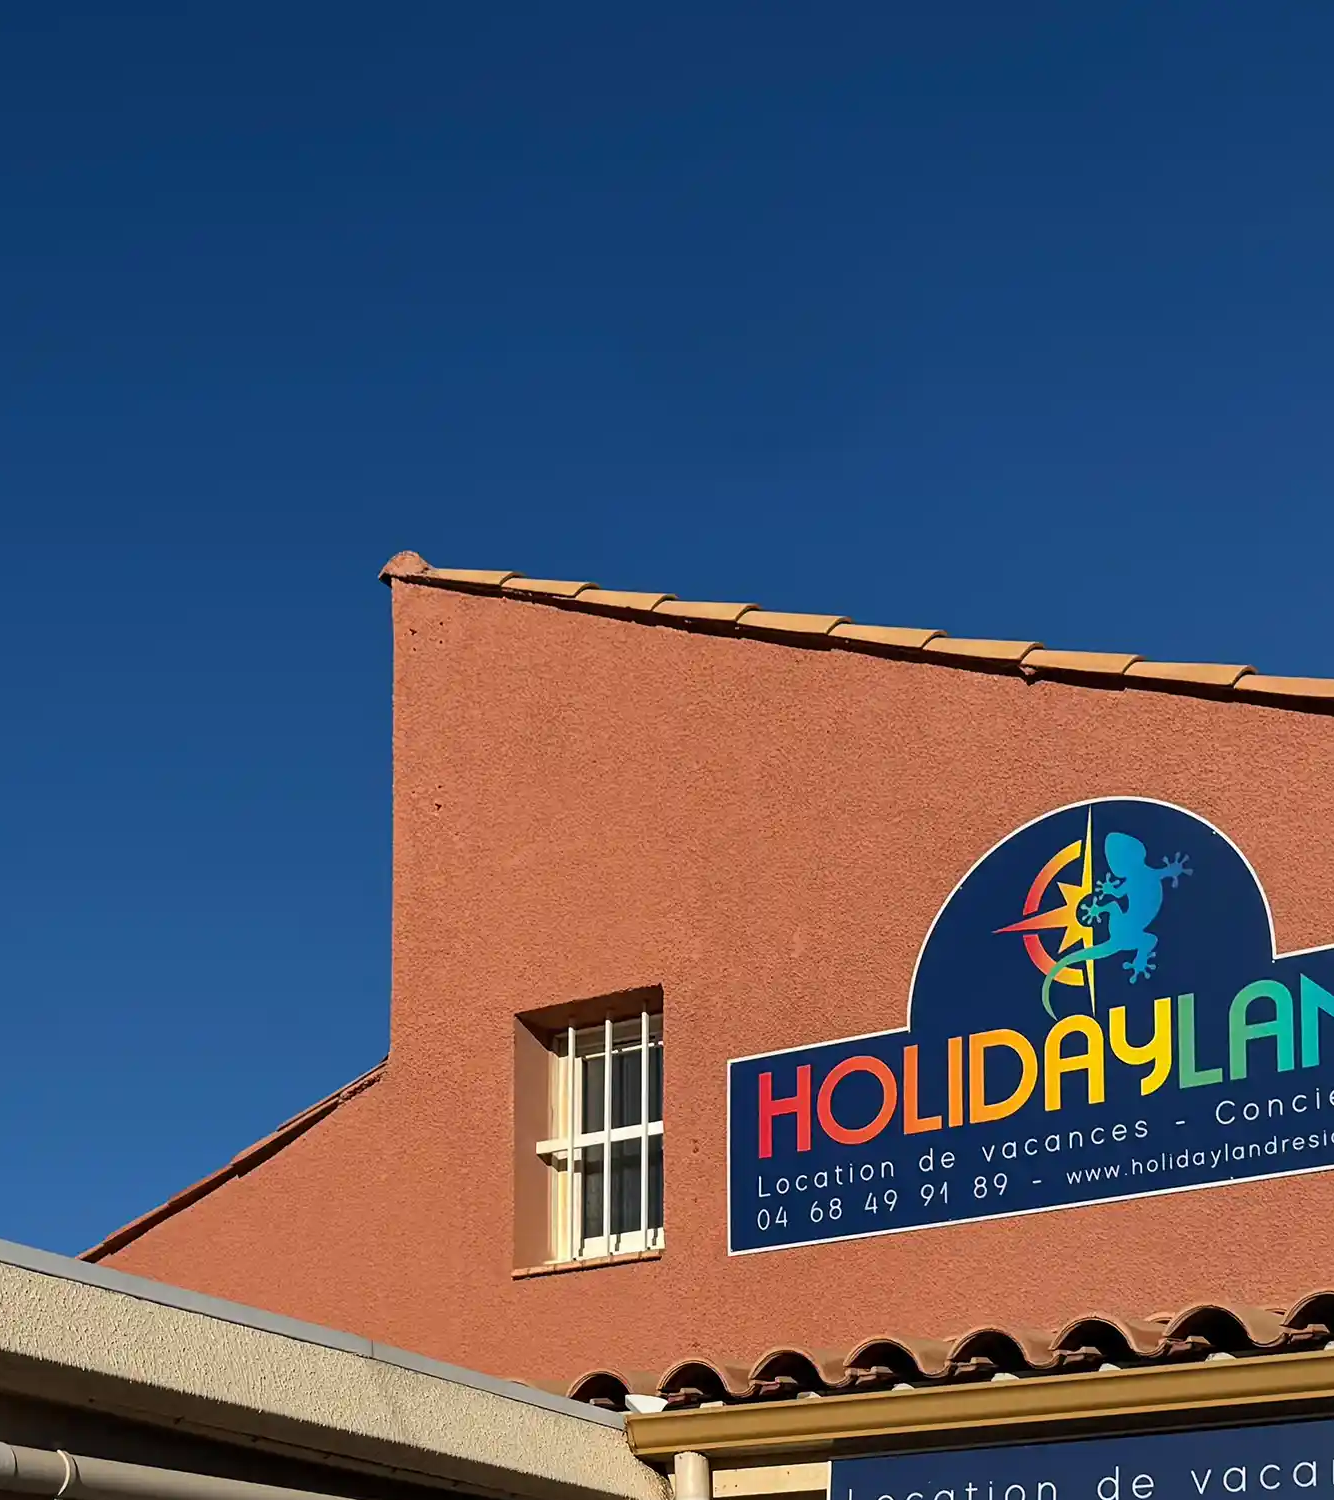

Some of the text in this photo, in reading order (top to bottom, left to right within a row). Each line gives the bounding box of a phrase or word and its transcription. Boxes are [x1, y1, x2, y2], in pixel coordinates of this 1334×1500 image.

[758, 1159, 895, 1198] Location
[919, 1148, 955, 1173] de
[982, 1117, 1149, 1163] vacances
[757, 1206, 789, 1232] 04
[810, 1197, 843, 1223] 68
[864, 1189, 898, 1215] 49
[920, 1181, 949, 1207] 91
[973, 1172, 1008, 1199] 89
